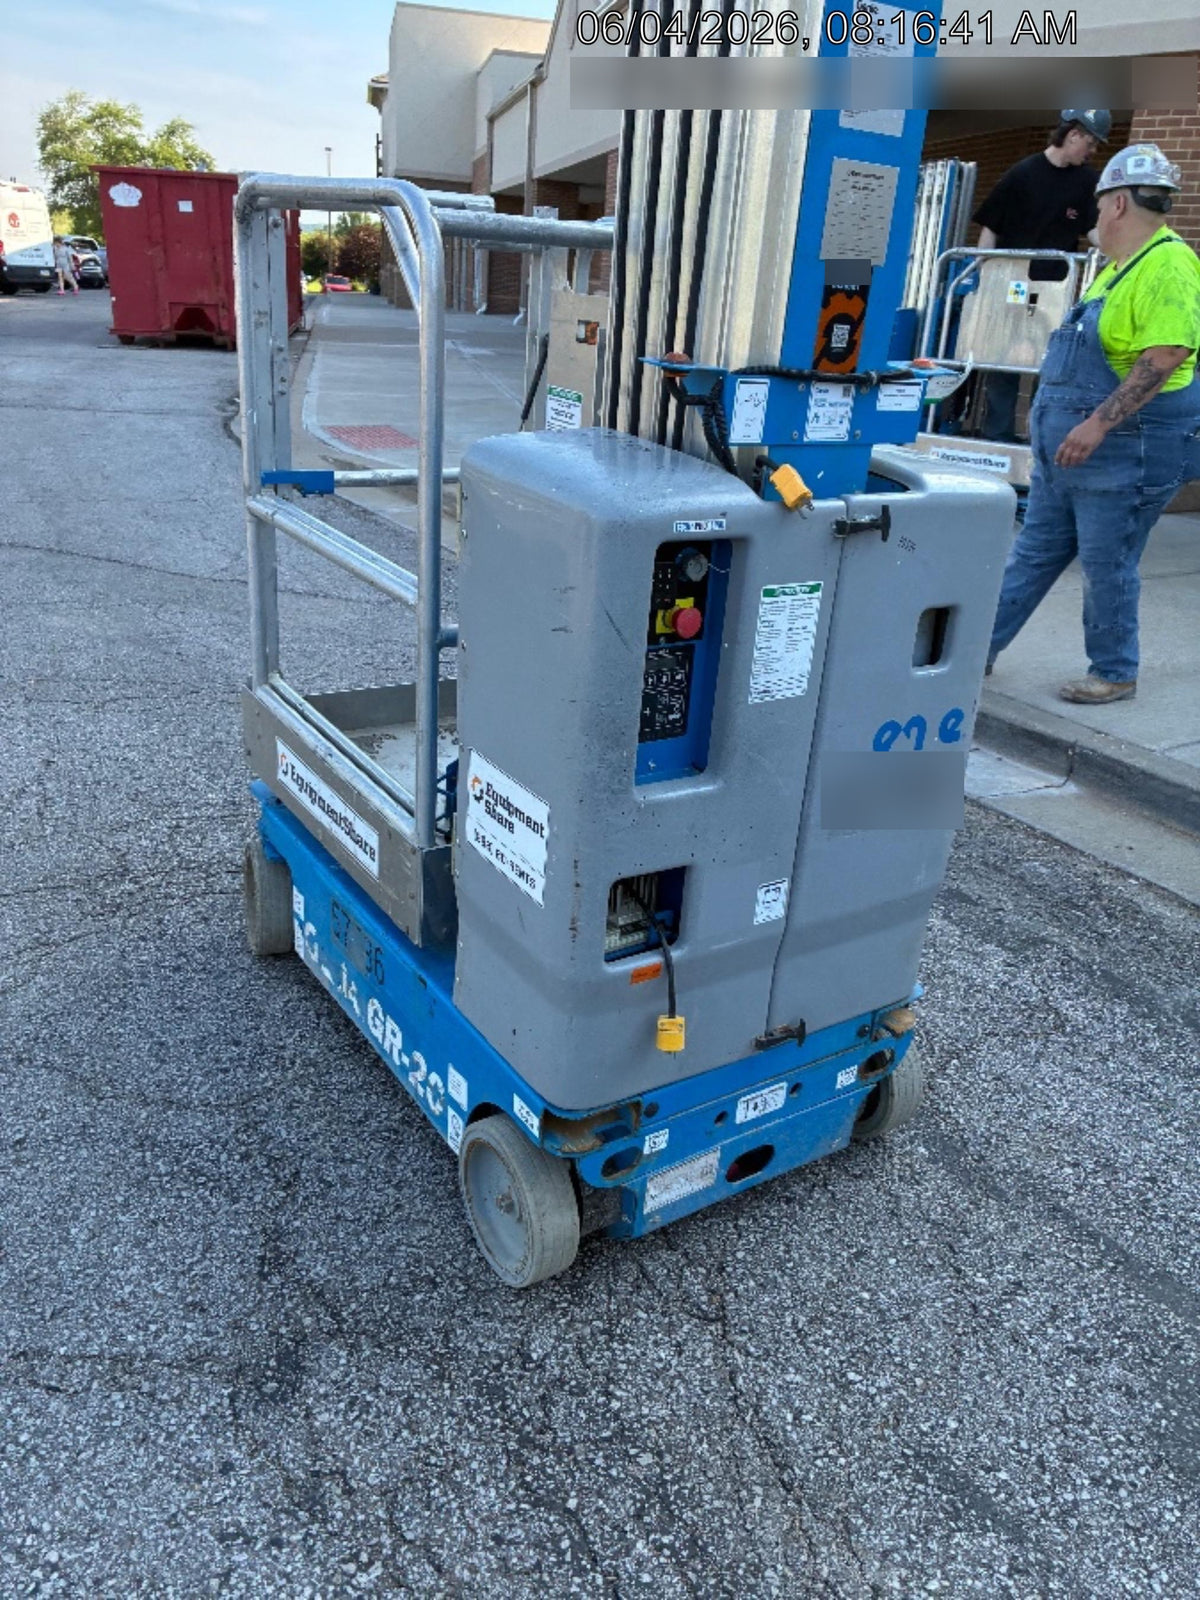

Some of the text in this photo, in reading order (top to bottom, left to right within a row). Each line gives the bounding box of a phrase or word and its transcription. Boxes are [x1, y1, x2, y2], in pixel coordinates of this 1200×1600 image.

[289, 761, 377, 863] EquipmentShare
[484, 781, 545, 839] Equipment
[484, 800, 515, 834] Share
